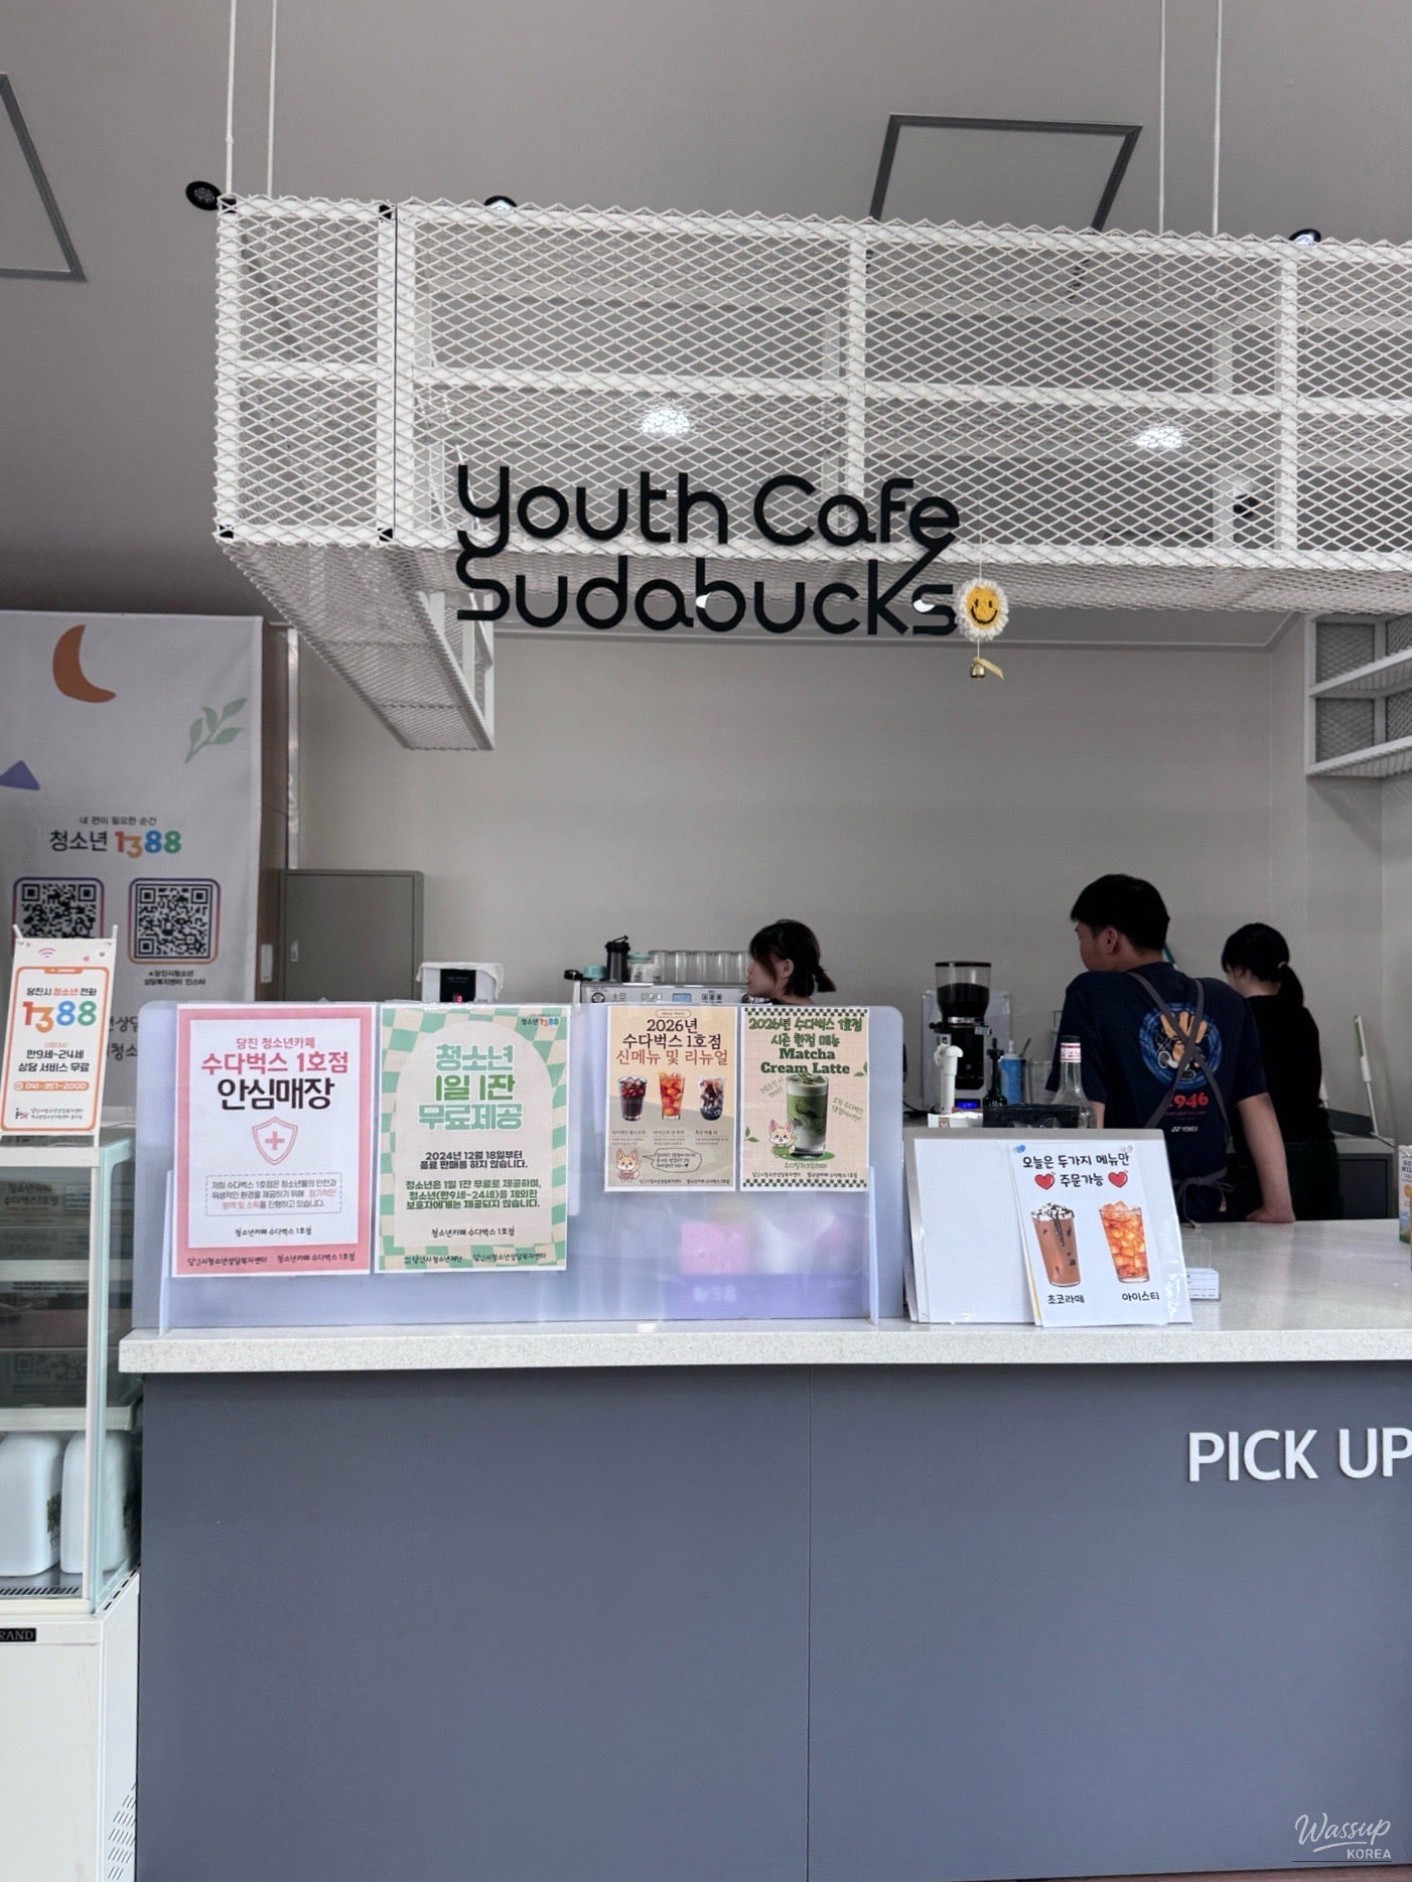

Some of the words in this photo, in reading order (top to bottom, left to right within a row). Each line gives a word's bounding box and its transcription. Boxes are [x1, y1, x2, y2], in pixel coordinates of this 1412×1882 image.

[754, 475, 960, 545] Cafe
[50, 830, 107, 852] 청소년
[114, 830, 181, 859] 1388
[23, 1000, 97, 1033] 1388
[647, 1018, 698, 1034] 2026년
[748, 1017, 792, 1031] 2026년
[794, 1017, 835, 1031] 수다벅스
[236, 1037, 258, 1049] 당진
[261, 1037, 316, 1049] 청소년카페
[622, 1033, 683, 1050] 수다벅스
[686, 1033, 722, 1050] 1호점
[770, 1033, 791, 1047] 시즌
[794, 1033, 815, 1047] 한정
[818, 1034, 841, 1047] 메뉴
[26, 1050, 84, 1059] 만9세~24세
[436, 1043, 513, 1072] 청소년
[616, 1049, 662, 1065] 신메뉴
[666, 1049, 680, 1065] 및
[685, 1049, 729, 1065] 리뉴얼
[779, 1048, 836, 1060] Matcha
[18, 1062, 38, 1072] 상담
[39, 1062, 68, 1072] 서비스
[70, 1062, 90, 1072] 무료
[201, 1053, 289, 1075] 수다벅스
[296, 1051, 348, 1073] 1호점
[760, 1062, 808, 1074] Cream
[812, 1062, 850, 1074] Latte
[217, 1078, 335, 1111] 안심매장
[436, 1074, 470, 1101] 1일
[479, 1074, 516, 1101] 1잔
[1169, 1092, 1209, 1109] 946
[418, 1103, 522, 1130] 무료제공
[425, 1151, 462, 1160] 2024년
[464, 1151, 483, 1160] 12월
[486, 1150, 523, 1160] 18일부터
[1022, 1156, 1054, 1169] 오늘은
[1057, 1155, 1092, 1168] 두가지
[1095, 1152, 1130, 1167] 메뉴만
[420, 1161, 437, 1170] 음료
[440, 1161, 467, 1169] 판매를
[470, 1160, 488, 1169] 하지
[490, 1160, 528, 1169] 않습니다.
[406, 1181, 441, 1190] 청소년은
[444, 1180, 457, 1189] 1일
[459, 1180, 472, 1189] 1잔
[474, 1180, 500, 1189] 무료로
[1060, 1174, 1104, 1187] 주문가능
[510, 1190, 538, 1198] 제외한
[407, 1200, 461, 1210] 보호자에게는
[463, 1199, 500, 1208] 제공되지
[502, 1199, 540, 1208] 않습니다.
[235, 1227, 267, 1237] 청소년카페
[269, 1226, 294, 1235] 수다벅스
[432, 1228, 466, 1238] 청소년카페
[468, 1228, 496, 1236] 수다벅스
[497, 1226, 515, 1236] 1호점
[1121, 1291, 1160, 1301] 아이스티
[1189, 1430, 1319, 1482] PICK
[1338, 1427, 1412, 1479] UP
